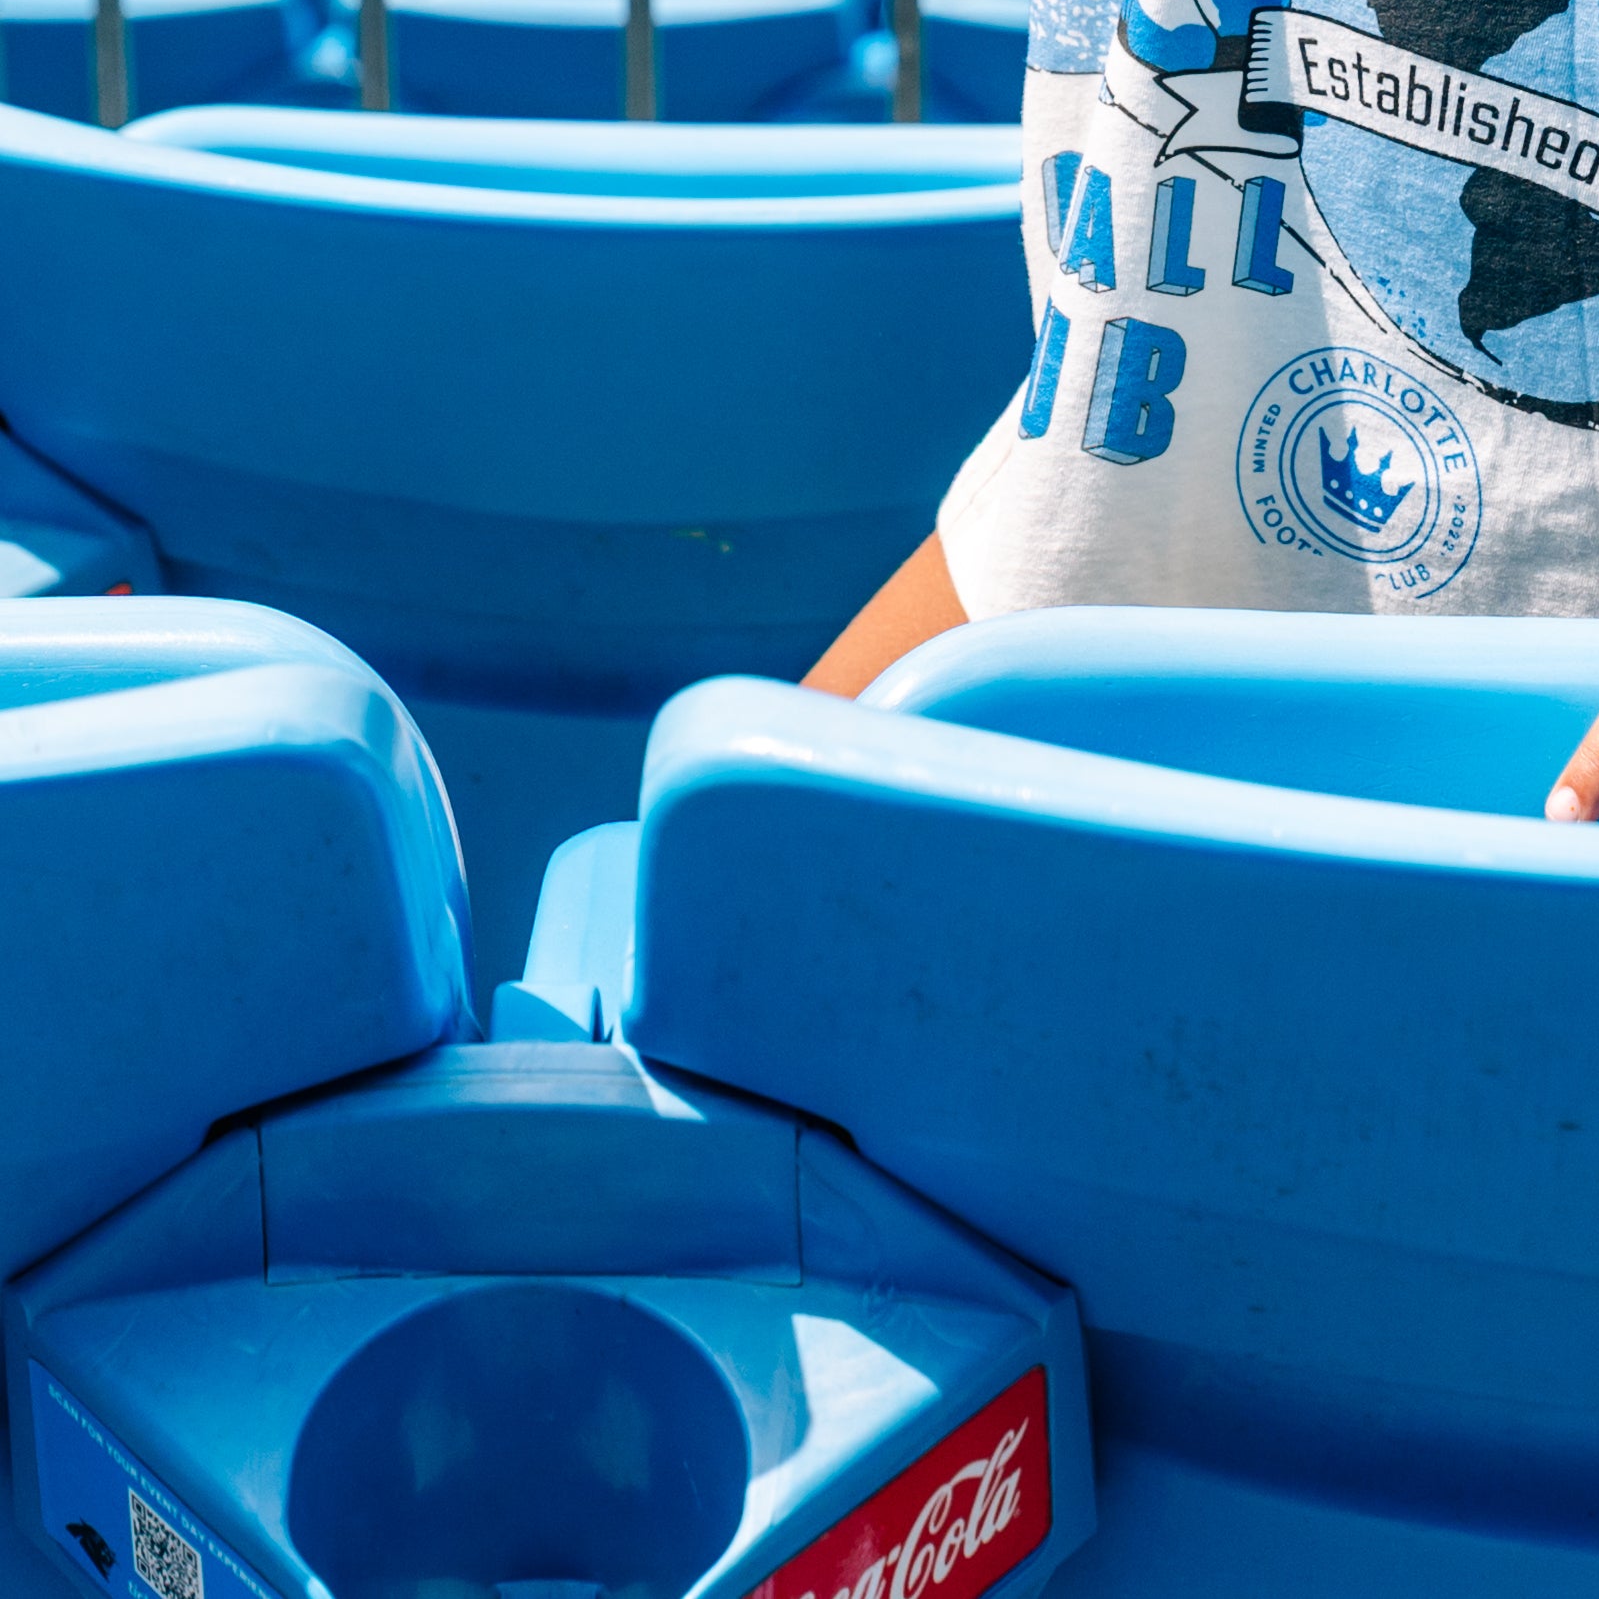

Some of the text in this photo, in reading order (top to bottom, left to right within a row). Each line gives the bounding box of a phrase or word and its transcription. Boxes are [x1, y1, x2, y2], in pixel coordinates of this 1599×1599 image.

[1253, 402, 1281, 474] MINTED
[1288, 357, 1468, 474] CHARLOTTE
[48, 1383, 79, 1422] SCAN
[81, 1417, 105, 1449] FOR
[106, 1442, 138, 1482] YOUR
[140, 1475, 178, 1520] EVENT
[181, 1513, 205, 1544] DAY
